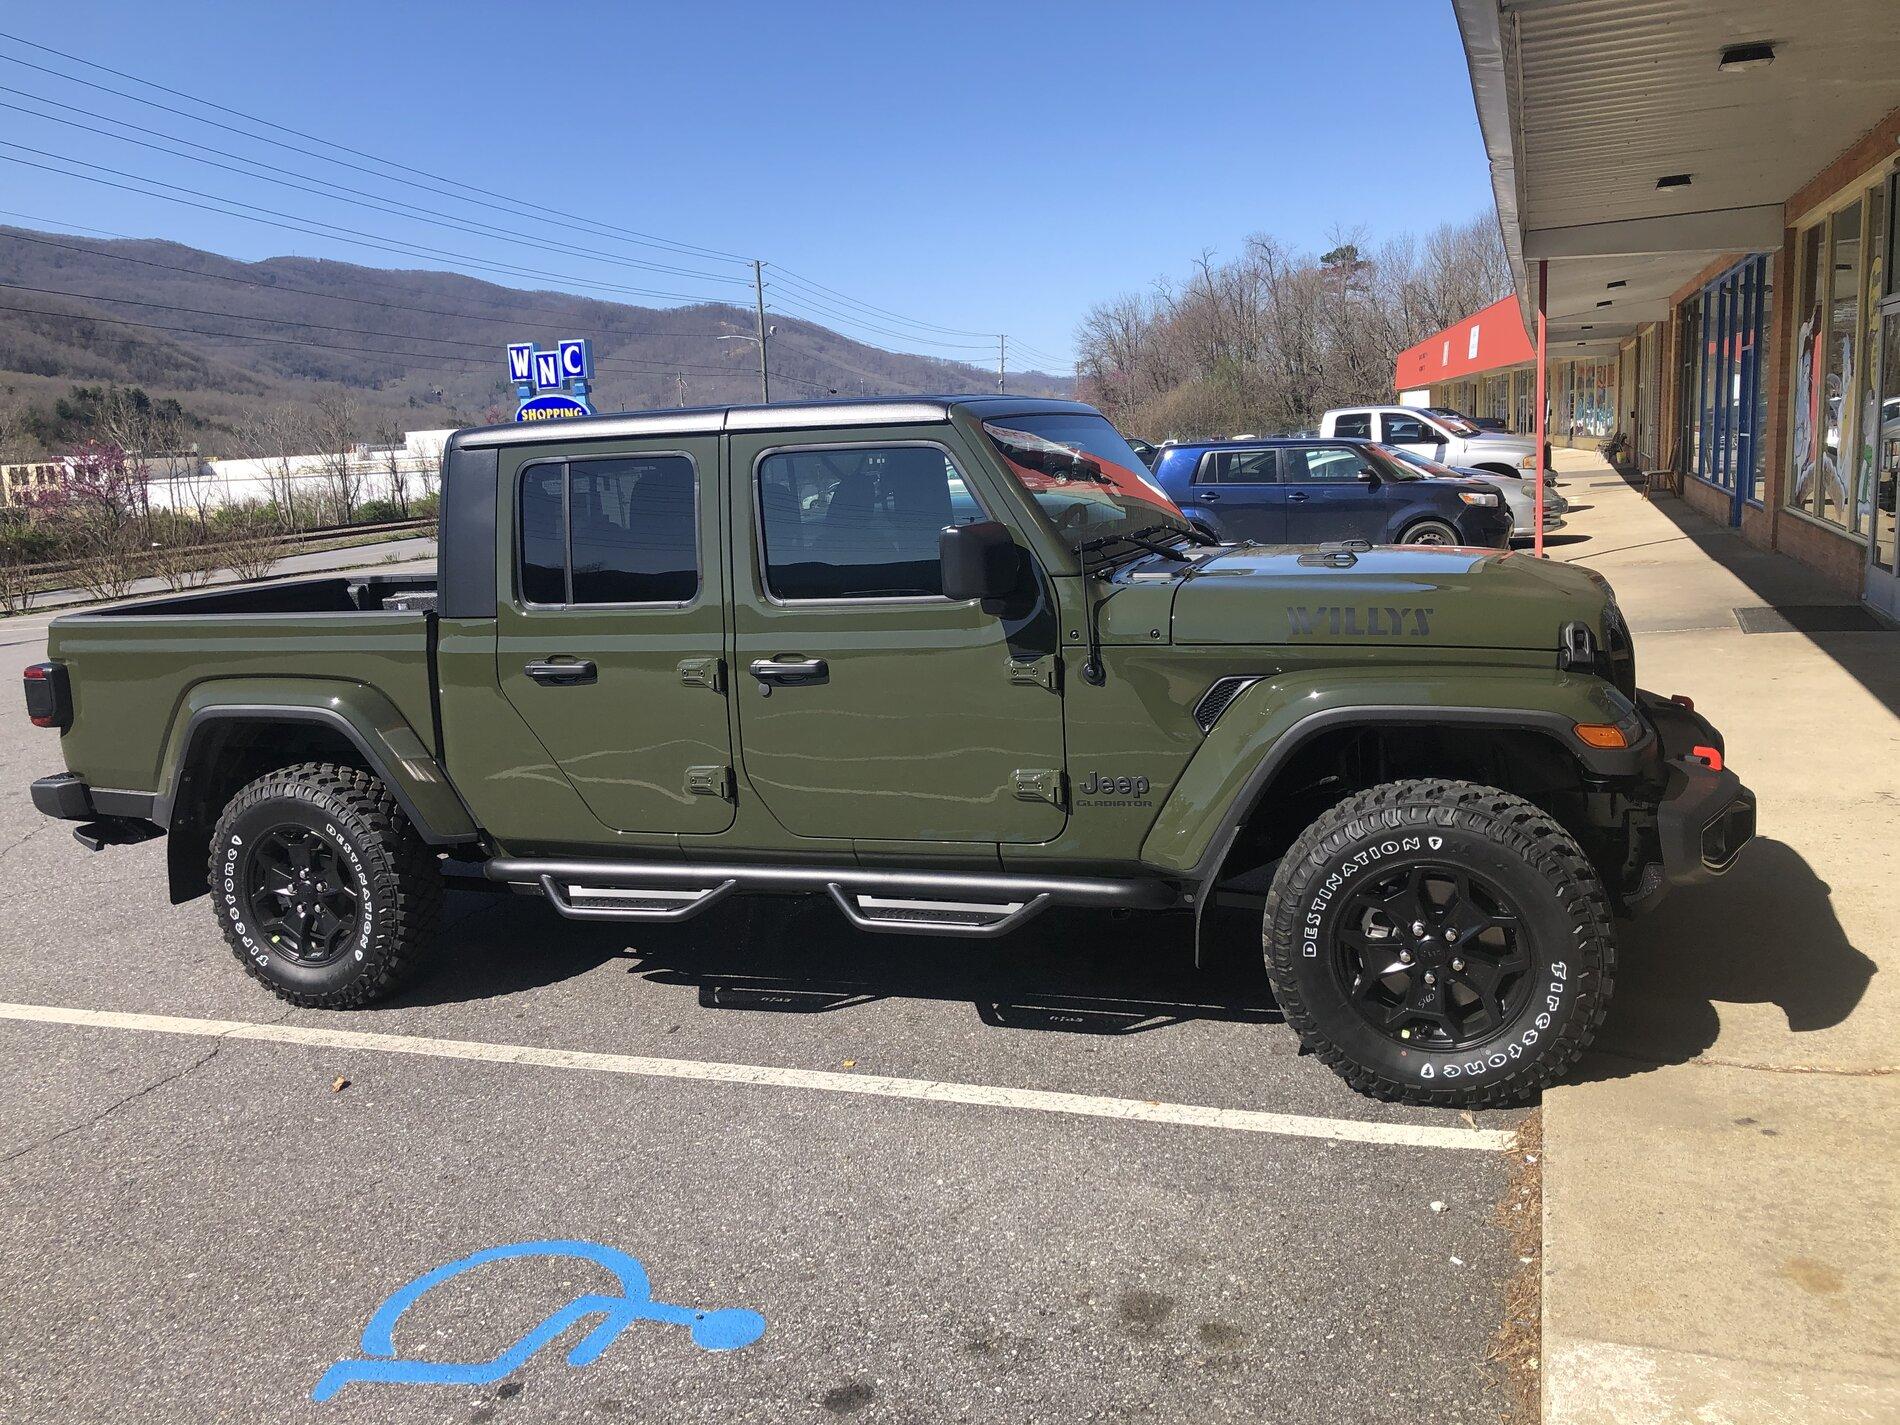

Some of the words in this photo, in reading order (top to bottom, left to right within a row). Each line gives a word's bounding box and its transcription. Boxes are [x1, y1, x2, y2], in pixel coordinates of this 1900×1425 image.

[521, 407, 583, 421] SHOPPING
[1286, 606, 1434, 636] WILLYS
[1080, 771, 1150, 798] Jeep
[325, 823, 373, 949] DESTINATION
[1302, 836, 1421, 958] DESTINATION
[1442, 961, 1567, 1078] Firestone
